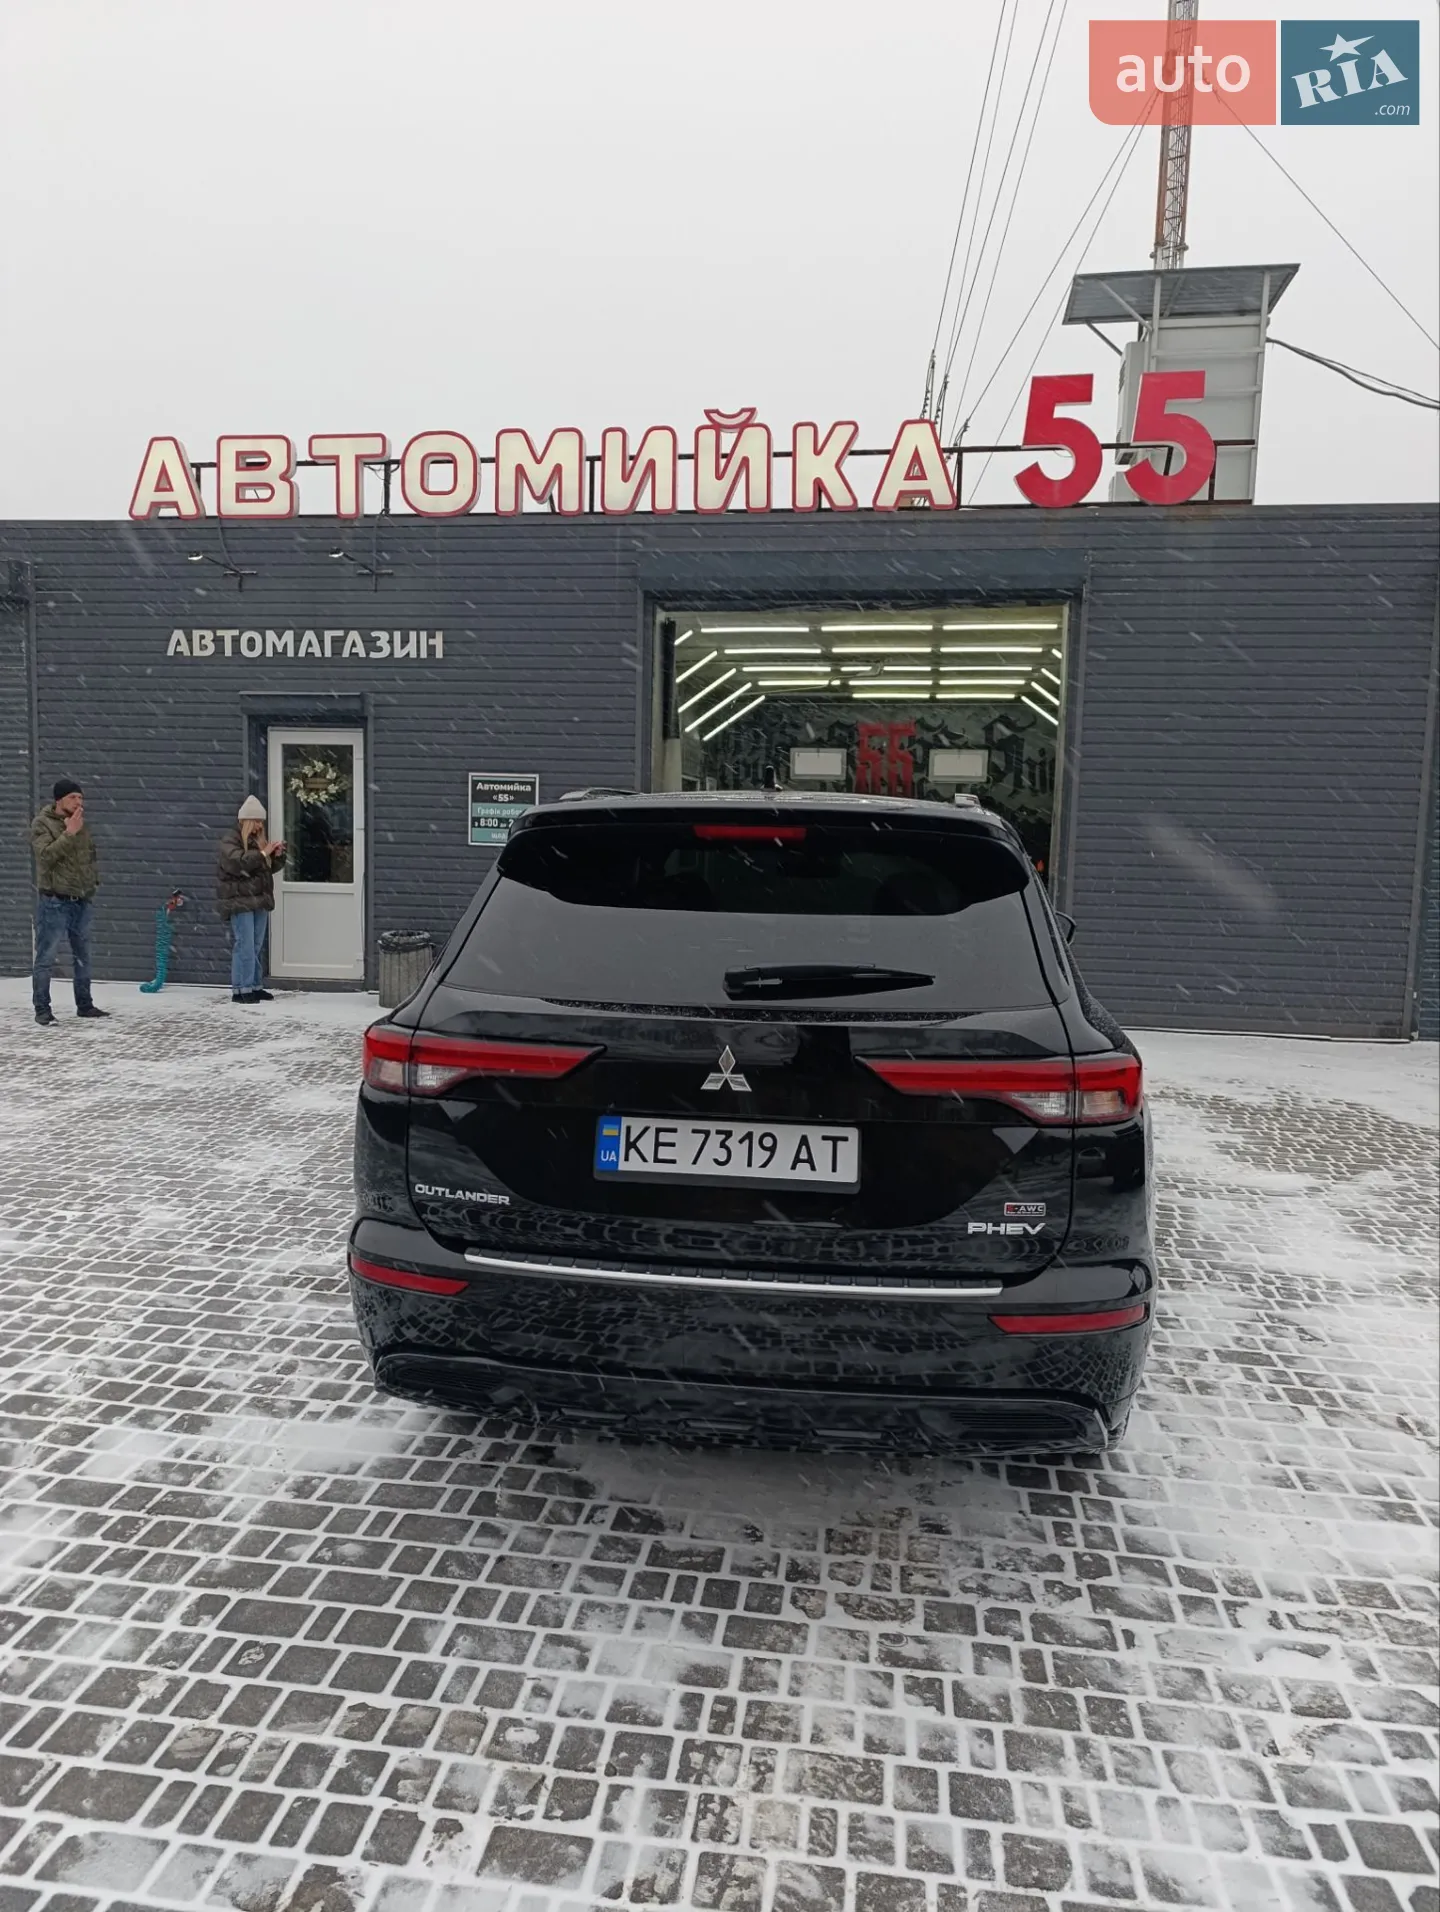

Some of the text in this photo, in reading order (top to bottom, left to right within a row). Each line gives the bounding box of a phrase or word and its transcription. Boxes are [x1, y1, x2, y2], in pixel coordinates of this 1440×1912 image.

[128, 369, 1216, 520] АВТОМИЙКА 55
[166, 628, 445, 660] АВТОМАГАЗИН
[476, 782, 532, 792] Автомийка
[480, 818, 499, 828] 8:00
[600, 1124, 850, 1174] UA KE 7319 AT
[414, 1183, 511, 1206] OUTLANDER
[967, 1222, 1047, 1236] PHEV
